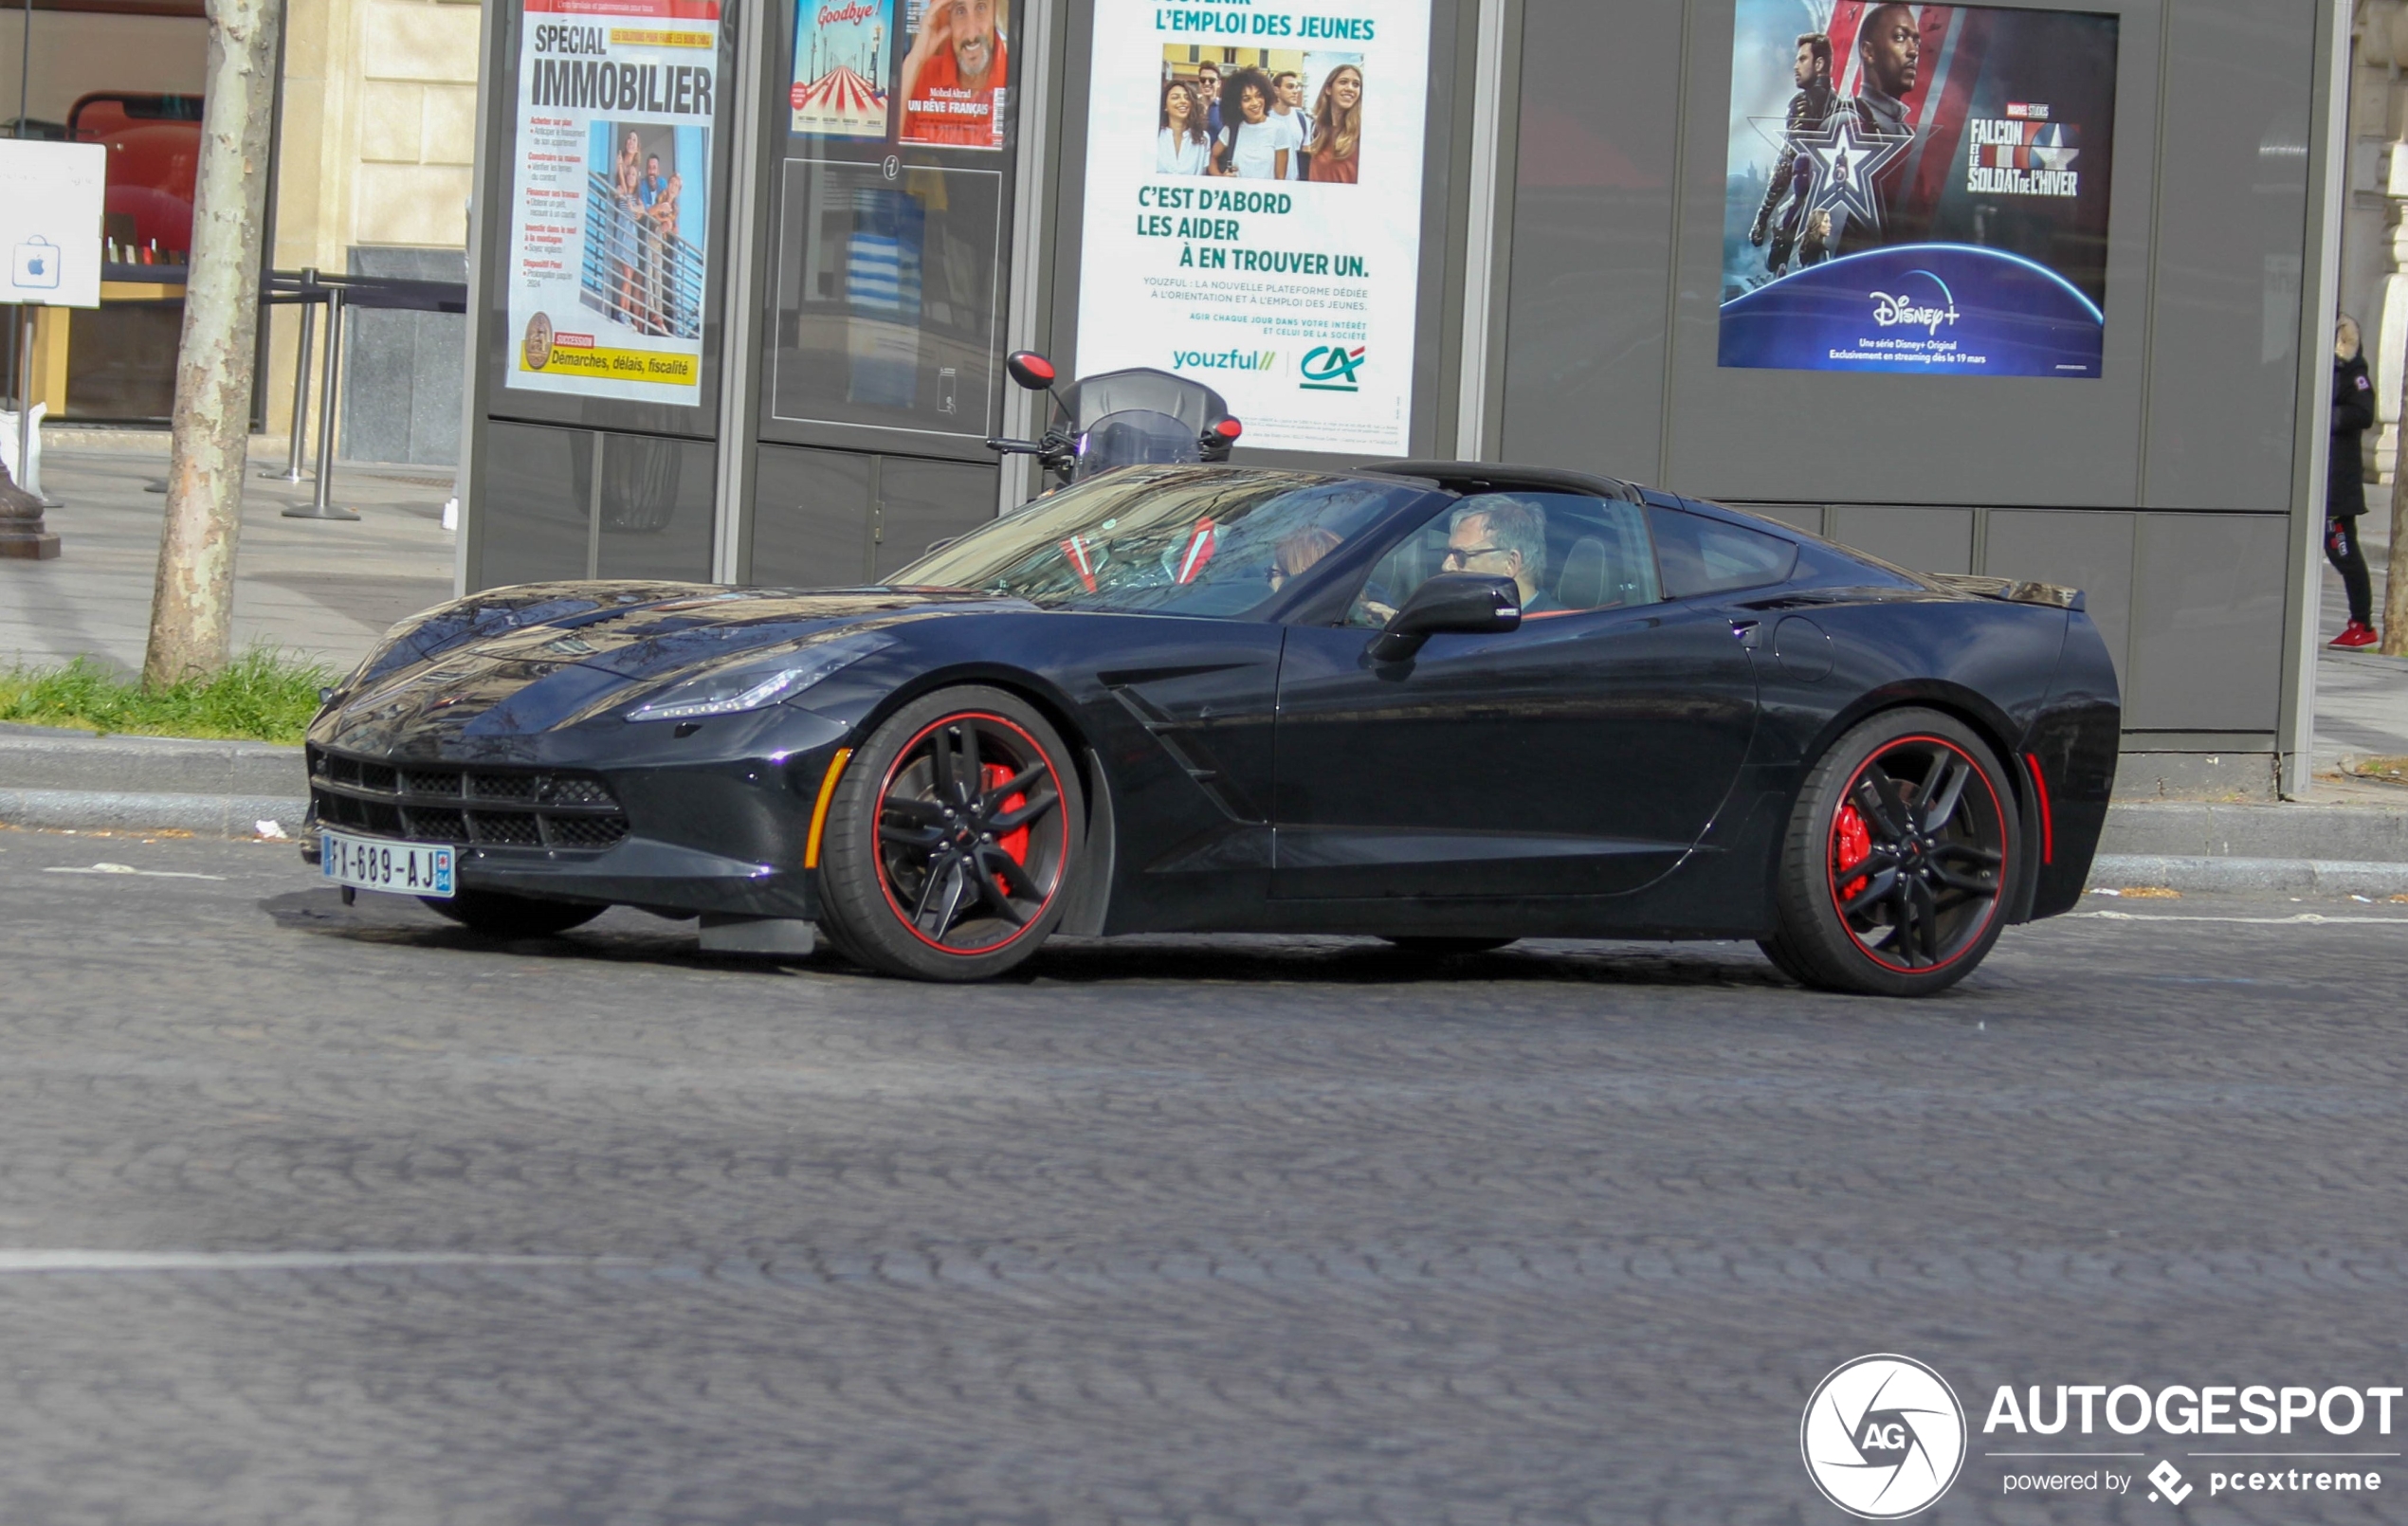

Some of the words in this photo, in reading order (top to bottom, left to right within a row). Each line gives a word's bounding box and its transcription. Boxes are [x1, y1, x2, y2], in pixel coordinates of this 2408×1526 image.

[1156, 9, 1246, 34] L'EMPLOI
[1251, 13, 1291, 36] DES
[1296, 16, 1375, 40] JEUNES
[535, 19, 607, 54] SPÉCIAL
[531, 58, 713, 116] IMMOBILIER
[908, 100, 921, 111] UN
[923, 98, 946, 113] RÊVE
[949, 101, 988, 118] FRANÇAIS
[1970, 118, 2023, 145] FALCON
[1970, 143, 1980, 154] ET
[1969, 155, 1979, 167] LE
[1967, 168, 2021, 193] SOLDAT
[2031, 170, 2078, 196] L'HIVER
[1138, 186, 1194, 209] C'EST
[1198, 189, 1292, 214] D'ABORD
[1137, 214, 1172, 237] LES
[1177, 217, 1239, 241] AIDER
[1179, 242, 1194, 267] À
[1199, 246, 1226, 269] EN
[1231, 248, 1328, 275] TROUVER
[1334, 254, 1369, 277] UN.
[1143, 277, 1187, 287] YOUZFUL
[1212, 282, 1263, 292] NOUVELLE
[1266, 284, 1329, 296] PLATEFORME
[1333, 287, 1368, 299] DÉDIÉE
[1151, 289, 1158, 299] À
[1160, 291, 1232, 302] L'ORIENTATION
[1235, 295, 1247, 303] ET
[1250, 294, 1257, 304] À
[1260, 297, 1303, 307] L'EMPLOI
[1305, 300, 1325, 308] DES
[1326, 300, 1368, 311] JEUNES.
[1213, 315, 1248, 323] CHAQUE
[1250, 316, 1272, 324] JOUR
[1276, 318, 1298, 326] DANS
[1302, 319, 1328, 328] VOTRE
[1331, 320, 1367, 330] INTÉRÊT
[1276, 328, 1301, 336] CELUI
[1331, 331, 1366, 340] SOCIÉTÉ
[1859, 338, 1875, 348] Une
[1876, 338, 1894, 349] série
[1896, 339, 1925, 351] Disney+
[1927, 340, 1957, 352] Original
[551, 351, 610, 371] Démarches,
[613, 355, 645, 374] délais,
[648, 357, 688, 375] fiscalité
[1829, 350, 1882, 360] Exclusivement
[1894, 352, 1930, 364] streaming
[1932, 352, 1946, 362] dès
[1947, 353, 1955, 362] le
[1957, 354, 1965, 363] 19
[1967, 355, 1986, 364] mars
